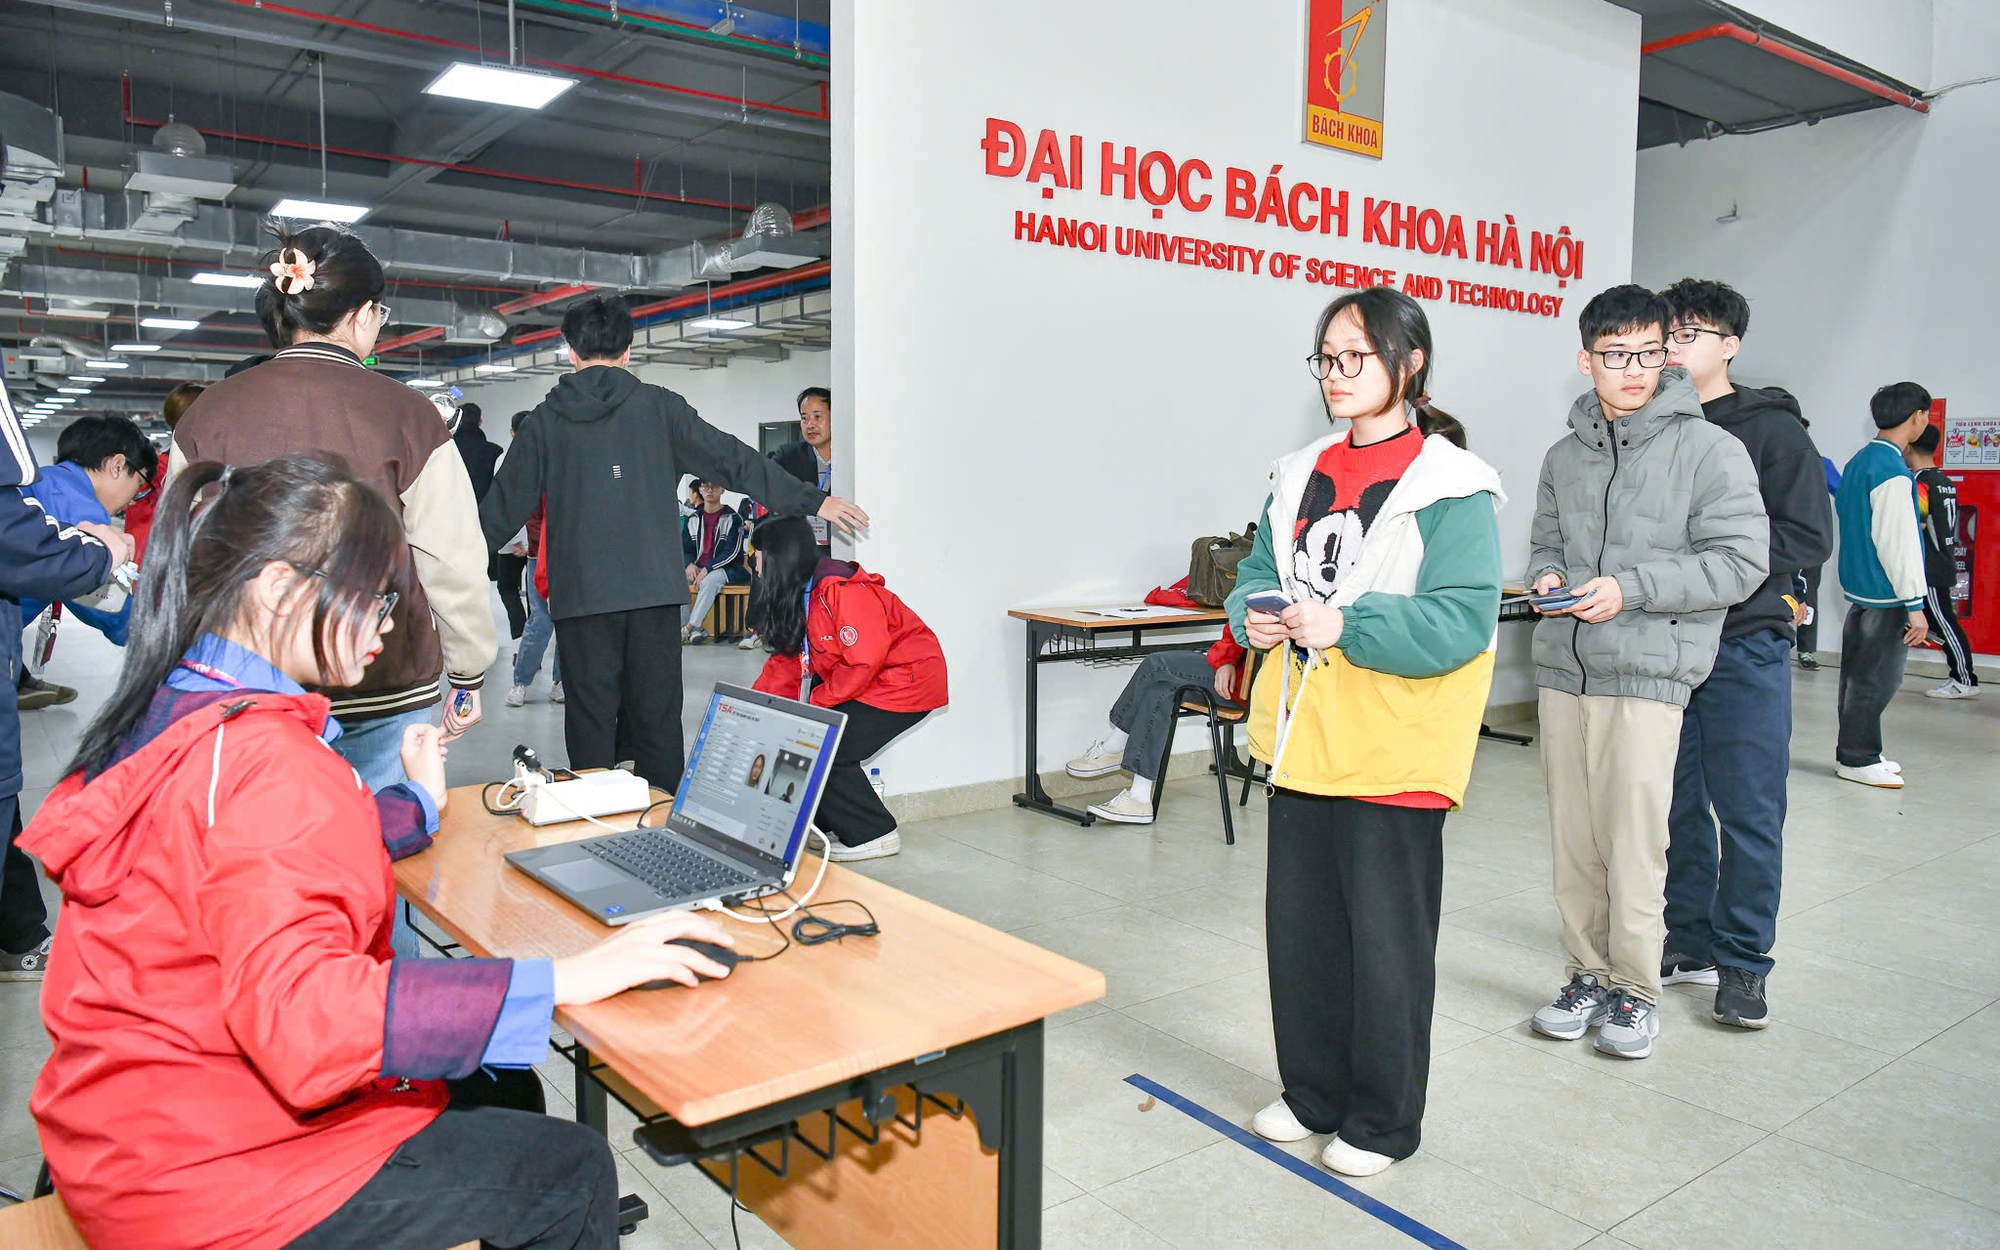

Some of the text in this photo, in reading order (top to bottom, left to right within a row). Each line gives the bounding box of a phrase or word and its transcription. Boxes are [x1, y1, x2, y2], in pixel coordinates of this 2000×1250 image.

[1312, 113, 1378, 148] BÁCH KHOA
[980, 117, 1584, 288] ĐẠI HỌC BÁCH KHOA HÀ NỘI
[1014, 210, 1563, 318] HANOI UNIVERSITY OF SCIENCE AND TECHNOLOGY
